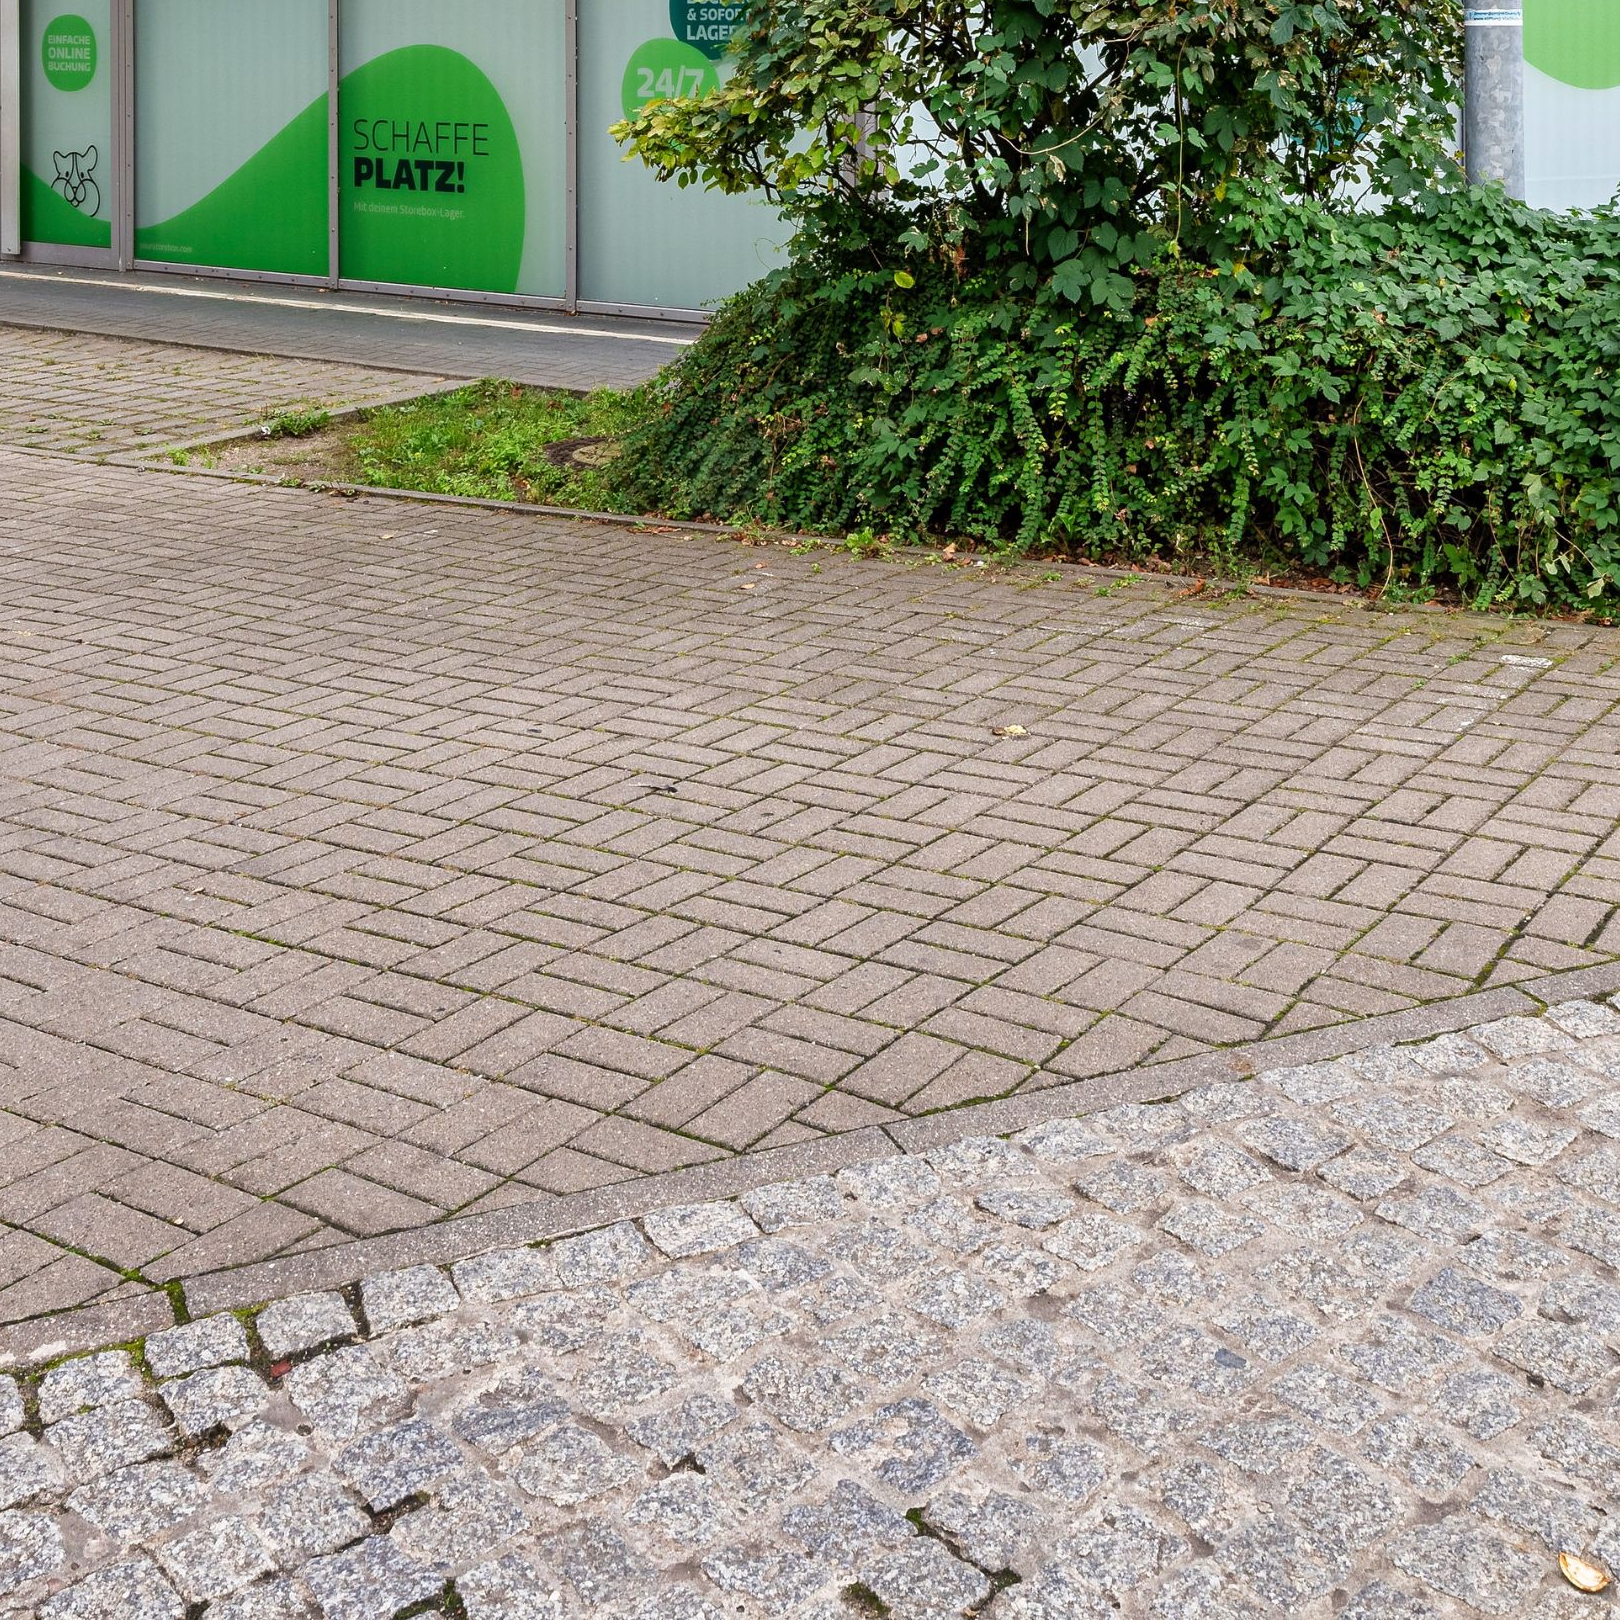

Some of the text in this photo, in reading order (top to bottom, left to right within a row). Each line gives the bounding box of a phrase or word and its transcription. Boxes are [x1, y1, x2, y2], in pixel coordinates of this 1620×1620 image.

[686, 8, 697, 21] &
[48, 35, 91, 46] EINFACHE
[48, 47, 91, 60] ONLINE
[48, 61, 91, 72] BUCHUNG
[636, 65, 704, 99] 24/7
[354, 118, 489, 156] SCHAFFE
[354, 156, 465, 193] PLATZ!
[354, 201, 466, 221] Mit deinem Storebox-Lager.
